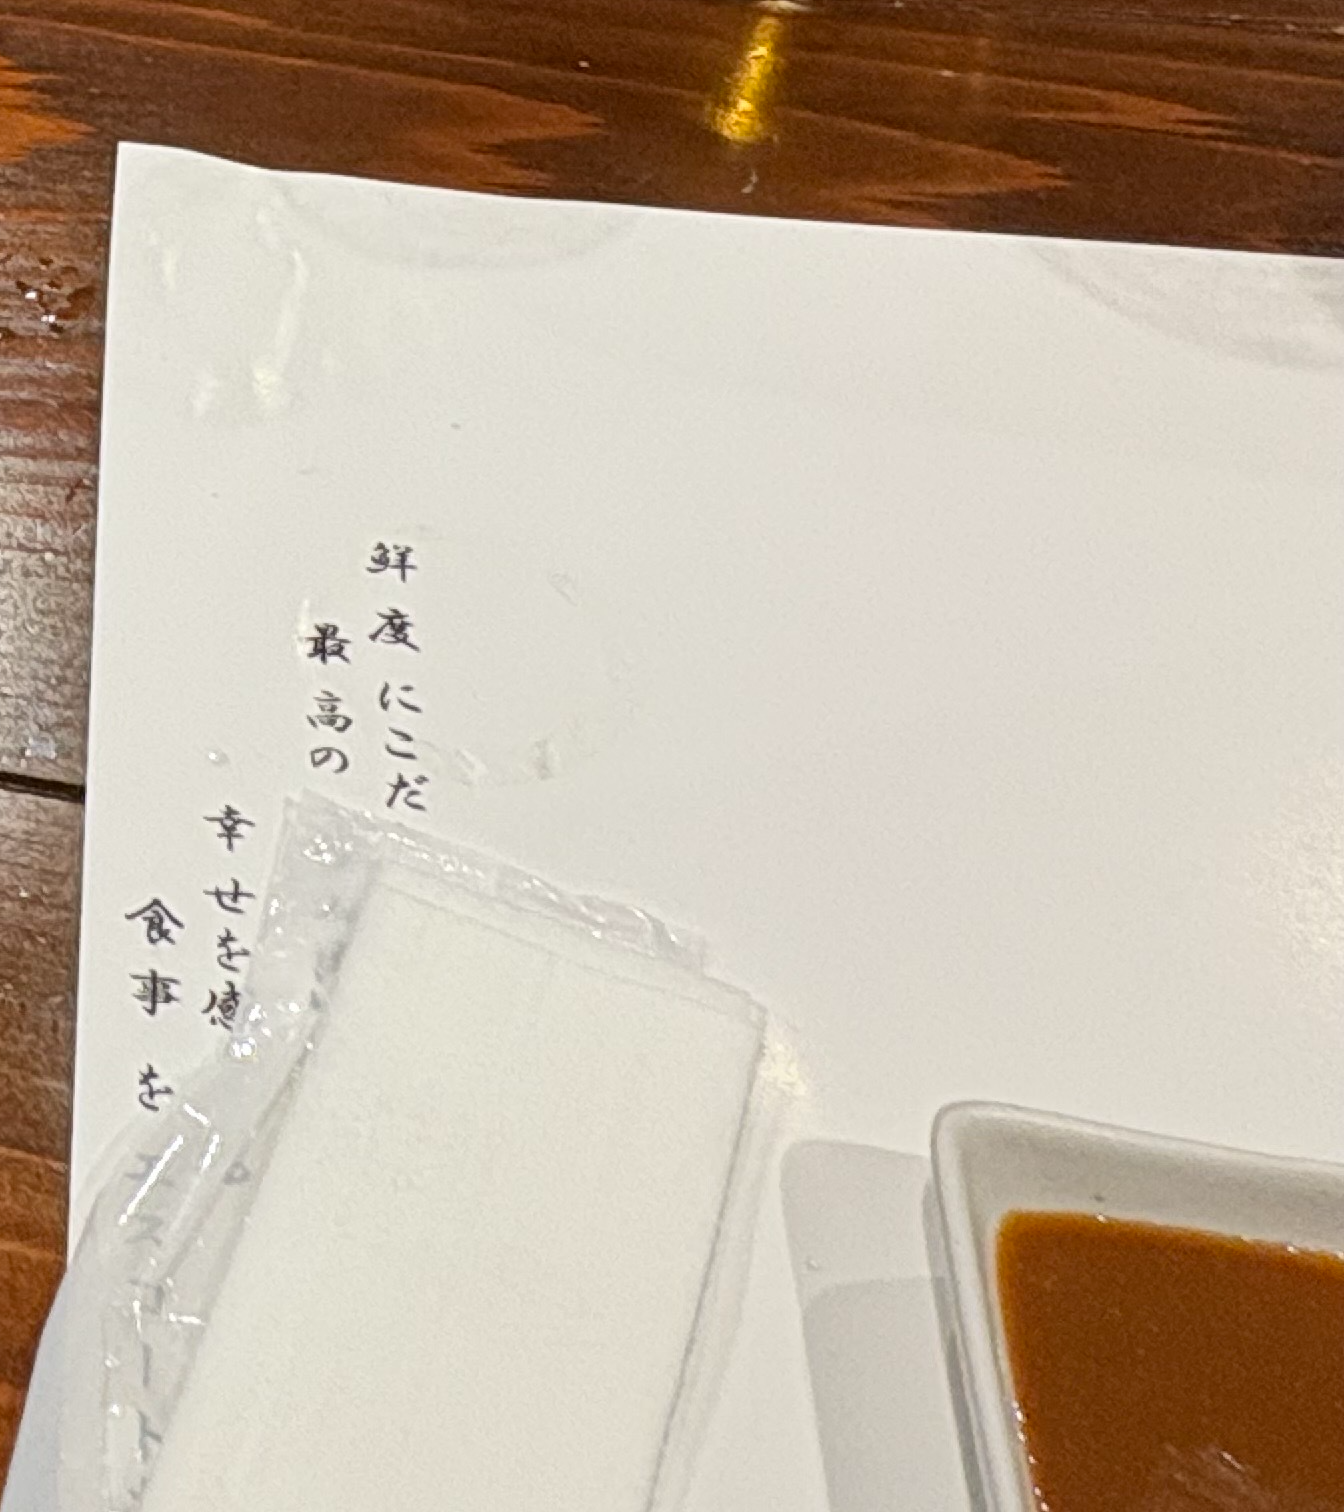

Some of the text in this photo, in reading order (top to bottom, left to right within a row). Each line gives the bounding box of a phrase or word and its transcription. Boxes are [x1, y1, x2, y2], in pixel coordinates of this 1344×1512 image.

[305, 623, 353, 775] 最高の
[365, 541, 430, 812] 鮮度にこだ
